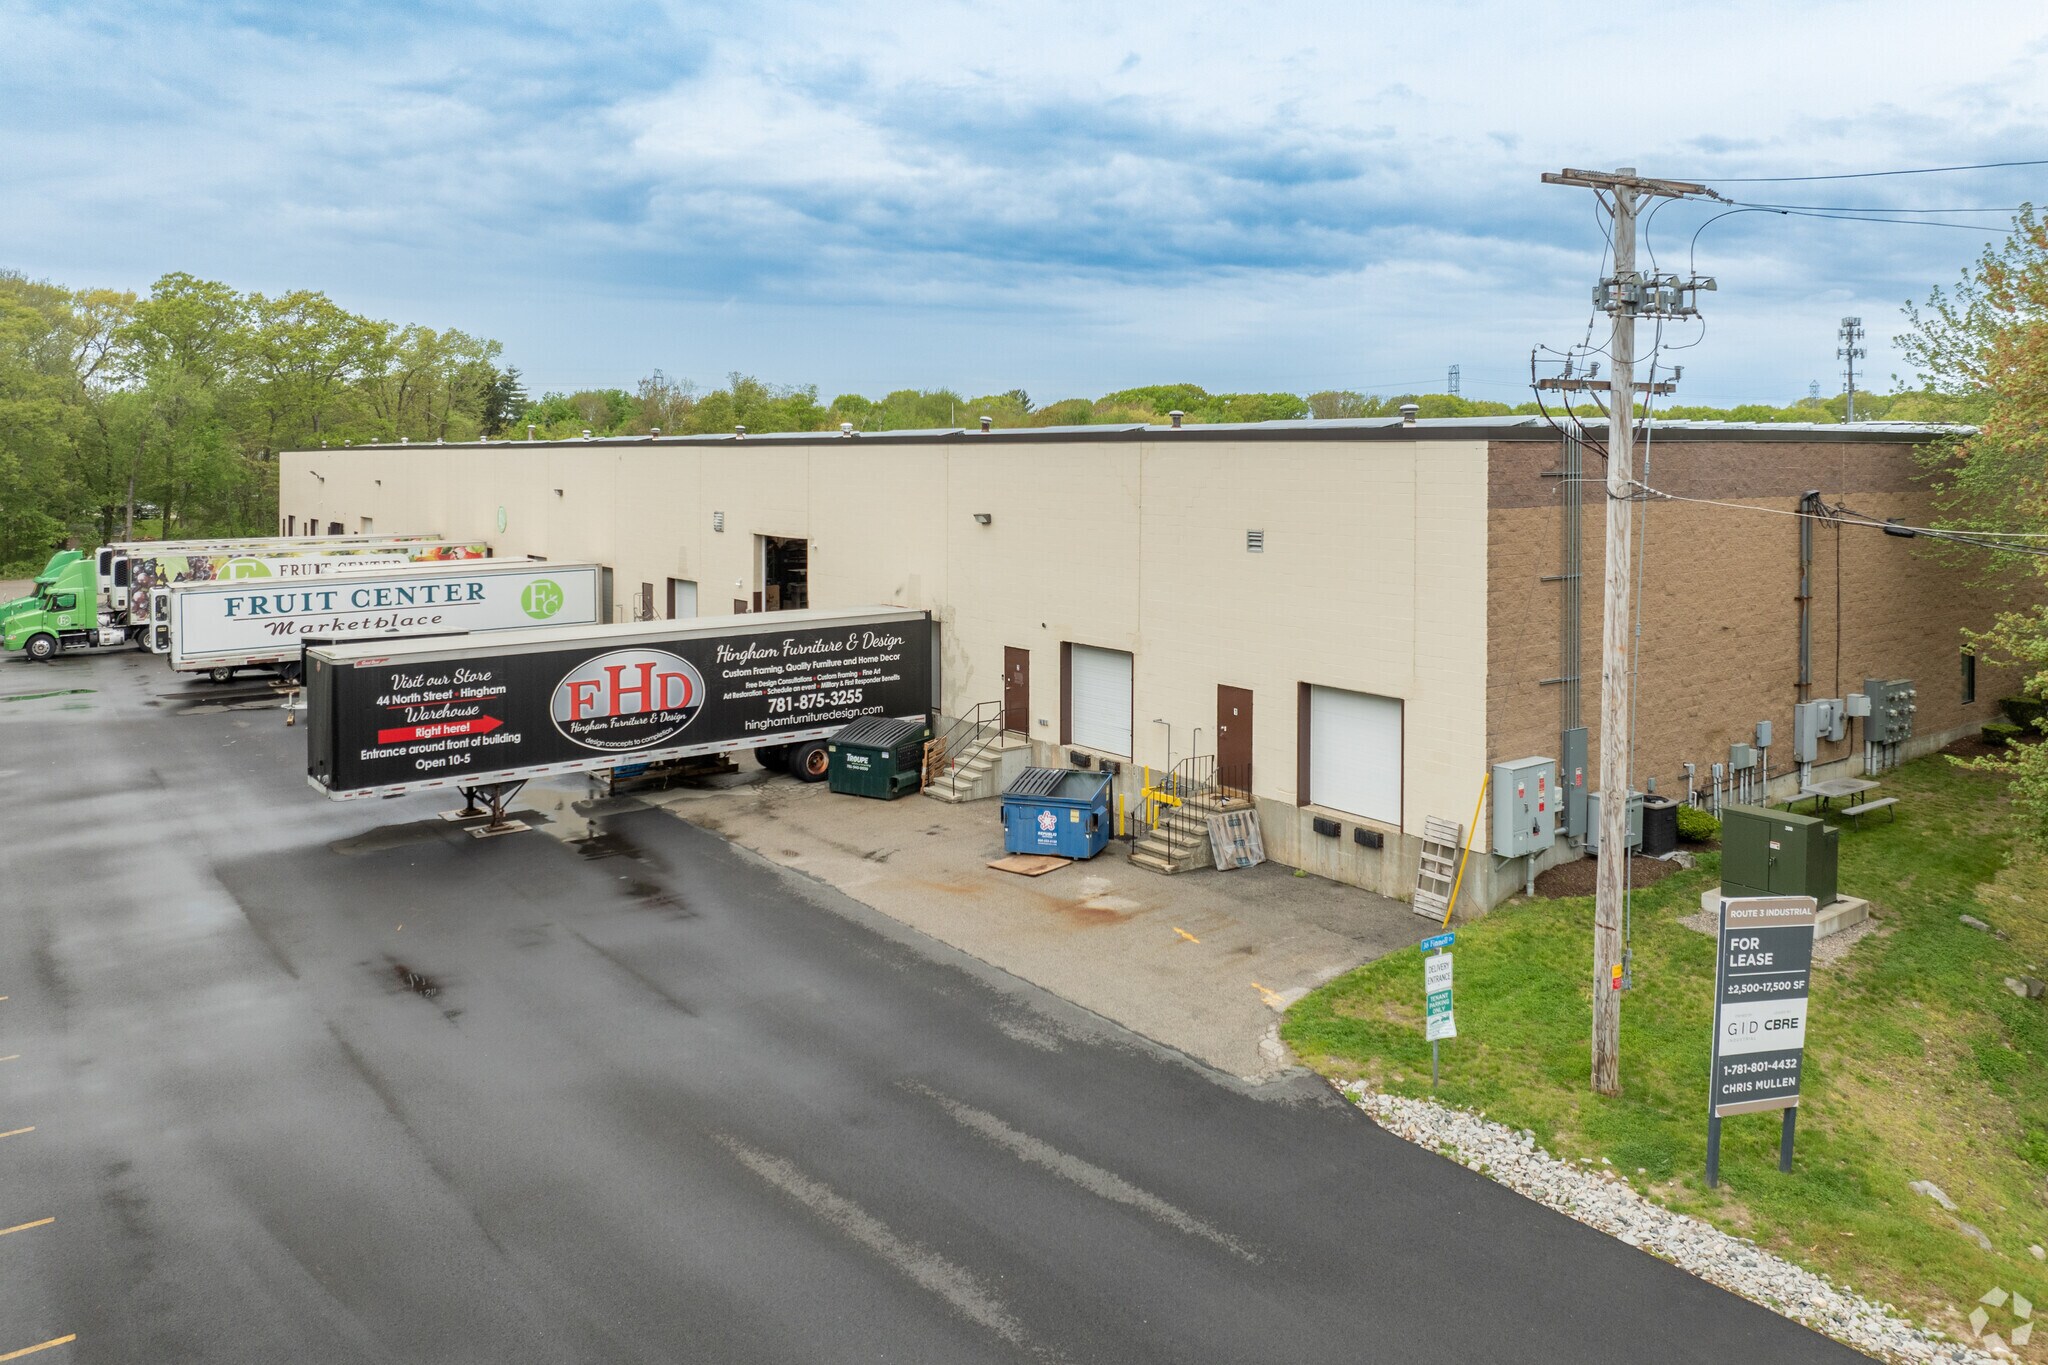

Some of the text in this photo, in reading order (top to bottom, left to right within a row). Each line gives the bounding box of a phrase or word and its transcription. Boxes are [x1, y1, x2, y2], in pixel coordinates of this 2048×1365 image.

[224, 582, 486, 617] FRUIT CENTER
[264, 614, 443, 636] Marketplace
[716, 631, 905, 665] Hingham Furniture & Design
[722, 653, 901, 679] Custom Framing, Quality Furniture and Home Decor
[391, 668, 492, 690] Visit our Store
[732, 688, 763, 698] Restoration
[767, 685, 792, 695] Schedule
[801, 683, 817, 691] event
[820, 680, 839, 690] Military
[844, 678, 854, 686] First
[854, 676, 881, 686] Responder
[881, 673, 901, 682] Benefits
[758, 678, 778, 688] Design
[778, 675, 813, 685] Consultations
[817, 672, 837, 681] Custom
[837, 670, 858, 680] Framing
[862, 668, 873, 676] Fine
[376, 685, 506, 706] 44 North Street Hingham
[566, 662, 693, 721] FHD
[768, 688, 863, 713] 781-875-3255
[405, 703, 480, 723] Warehouse
[570, 710, 687, 734] Hingham Furniture & Design
[745, 705, 884, 731] hinghamfurnituredesign.com
[415, 722, 470, 739] Right here!
[585, 737, 605, 747] design
[605, 739, 634, 748] concepts
[641, 727, 674, 744] completion
[361, 732, 522, 760] Entrance around front of building
[415, 753, 471, 771] Open 10-5
[1730, 908, 1812, 918] ROUTE 3 INDUSTRIAL
[1730, 937, 1760, 951] FOR
[1428, 962, 1449, 974] DELIVERY
[1729, 952, 1774, 967] LEASE
[1427, 972, 1451, 986] ENTRANCE
[1727, 980, 1805, 994] ±2,500-17,500 SF
[1429, 1000, 1450, 1009] PARKING
[1430, 992, 1449, 1001] TENANT
[1432, 1006, 1446, 1015] ONLY
[1764, 1017, 1799, 1031] CBRE
[1723, 1058, 1797, 1076] 1-781-801-4432
[1722, 1076, 1796, 1095] CHRIS MULLEN
